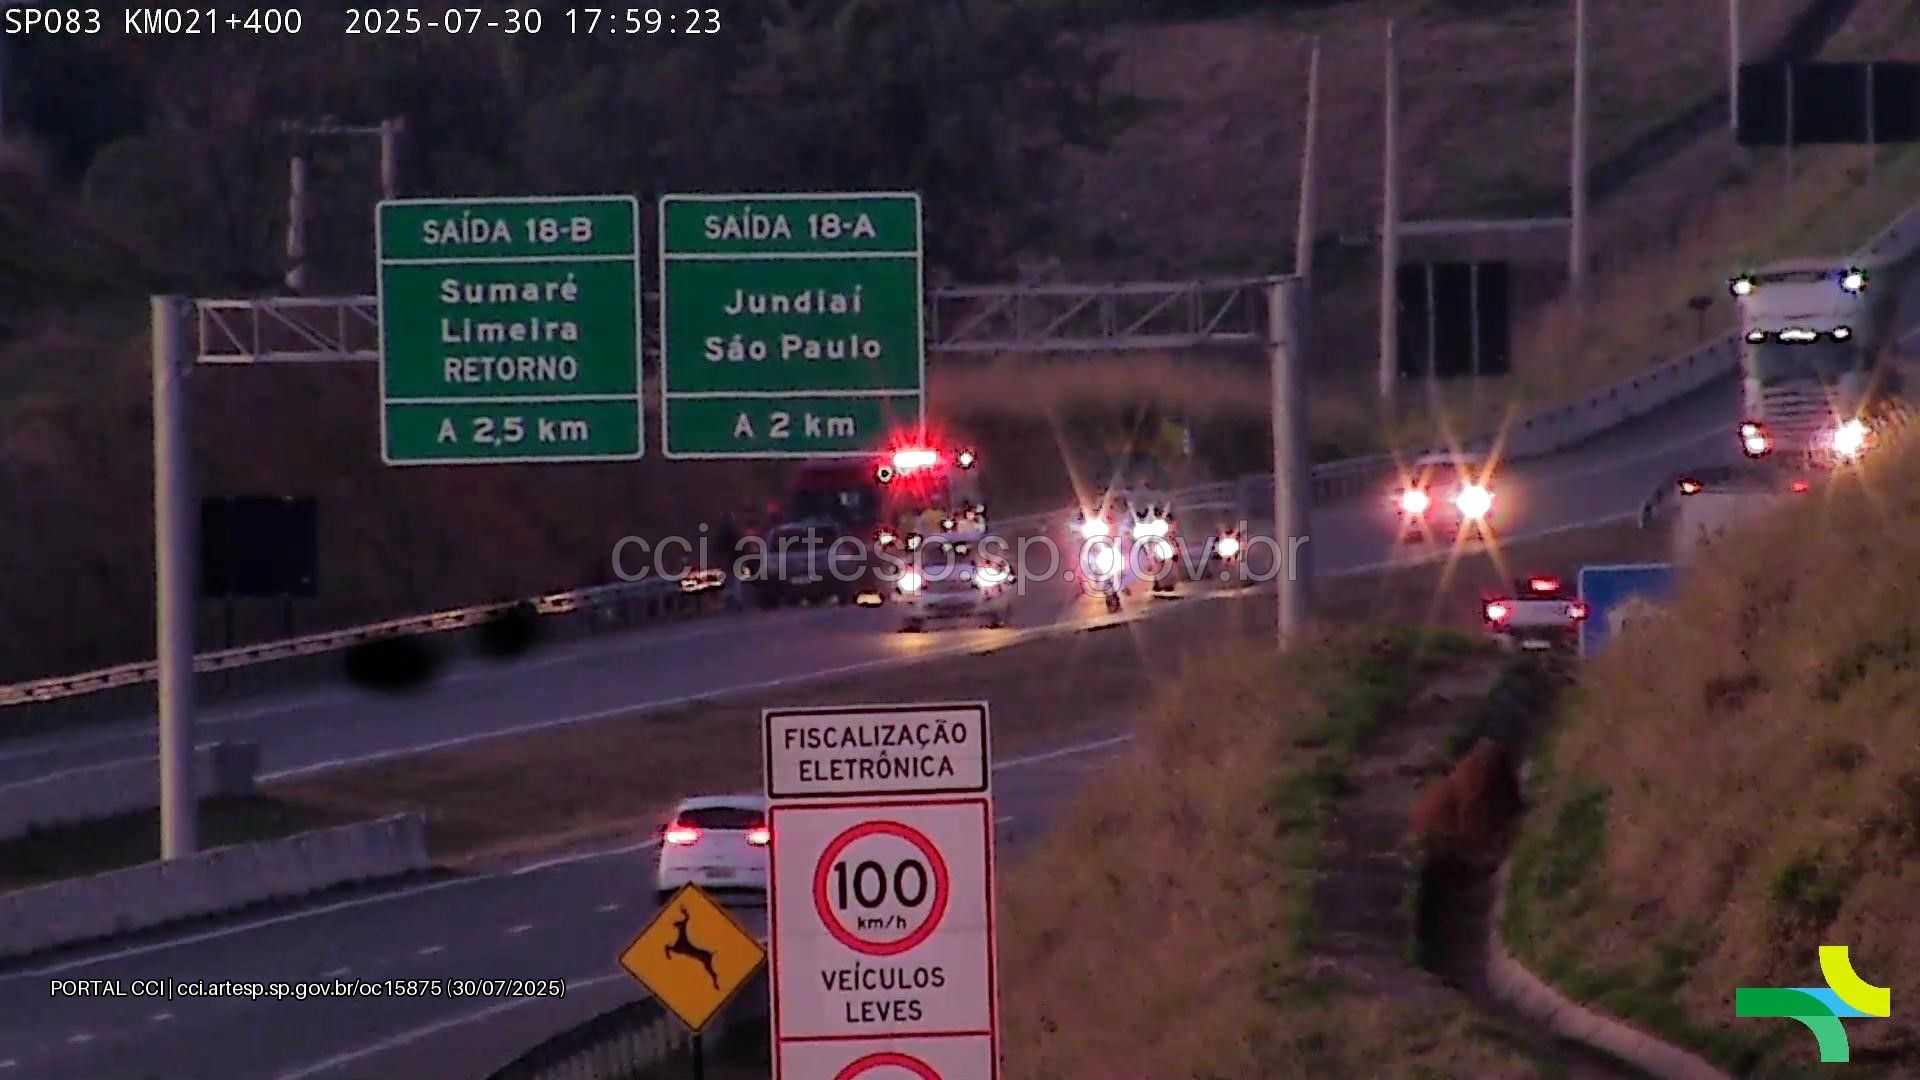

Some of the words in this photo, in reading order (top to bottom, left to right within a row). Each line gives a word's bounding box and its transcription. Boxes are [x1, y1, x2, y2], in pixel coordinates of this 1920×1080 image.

[423, 210, 511, 244] SAÍDA
[526, 217, 592, 243] 18-B
[704, 206, 791, 240] SAÍDA
[808, 213, 876, 239] 18-A
[440, 273, 578, 304] Sumaré
[724, 284, 863, 315] Jundiaí
[441, 318, 578, 342] Limeira
[705, 334, 767, 361] São
[781, 334, 881, 360] Paulo
[444, 356, 577, 383] RETORNO
[437, 418, 457, 443] A
[472, 416, 524, 446] 2,5
[538, 417, 588, 441] km
[734, 413, 753, 438] A
[769, 412, 790, 438] 2
[805, 413, 855, 437] km
[785, 719, 967, 749] FISCALIZAÇÃO
[800, 750, 954, 782] ELETRÔNICA
[834, 859, 928, 910] 100
[857, 915, 907, 930] km/h
[821, 962, 945, 991] VEÍCULOS
[846, 1000, 923, 1023] LEVES
